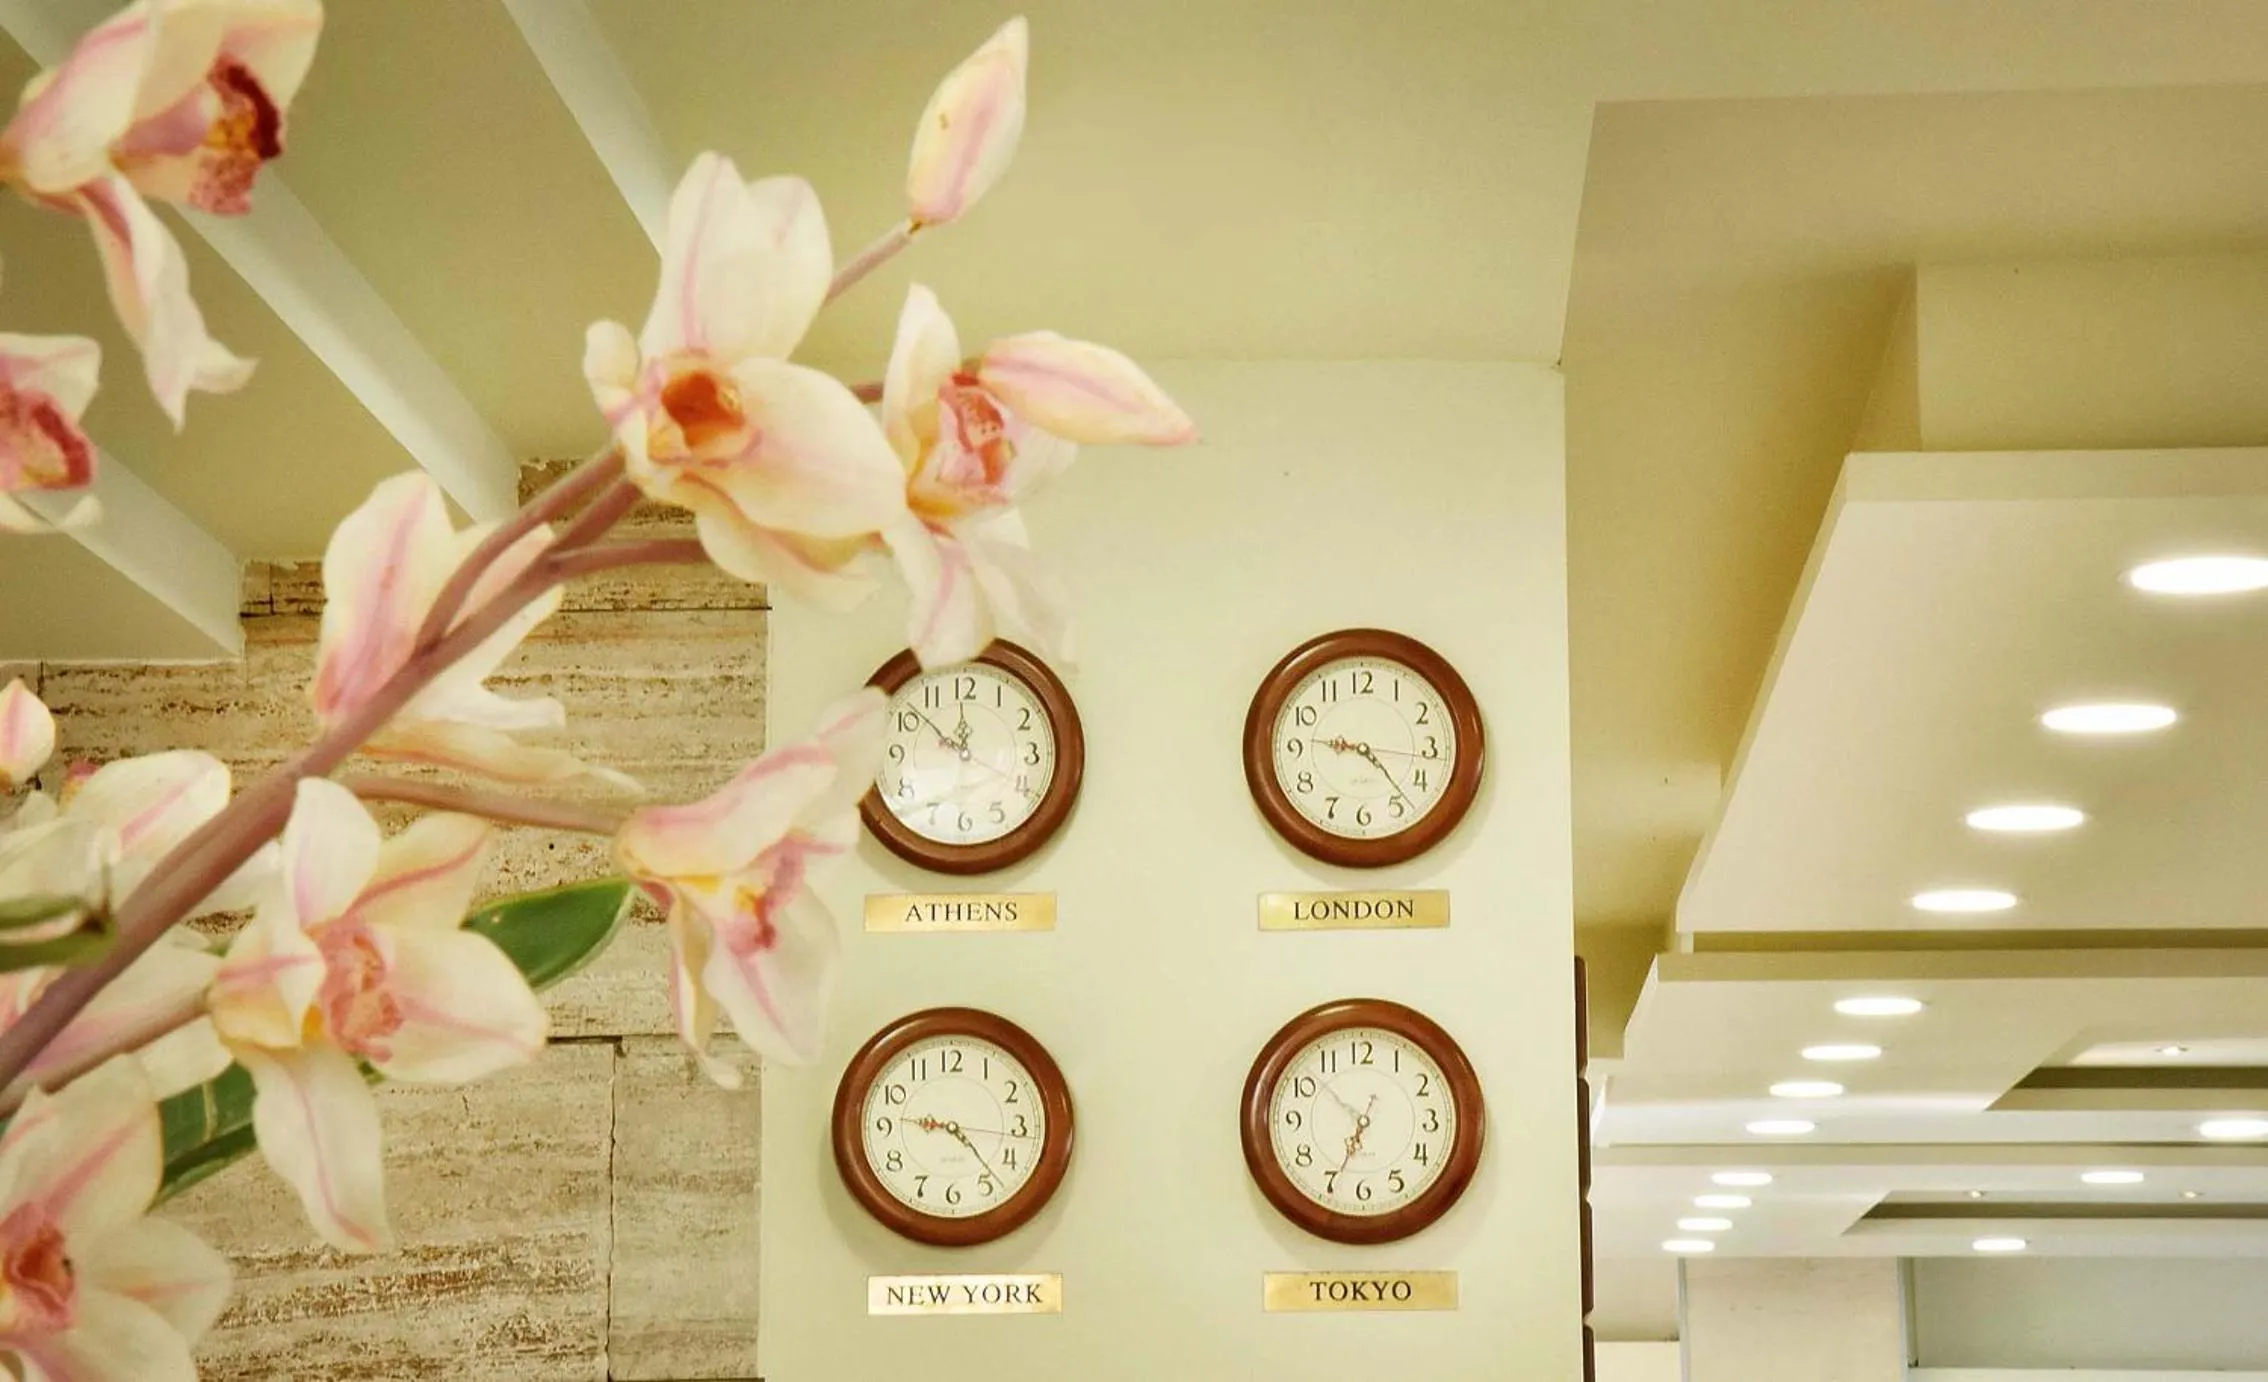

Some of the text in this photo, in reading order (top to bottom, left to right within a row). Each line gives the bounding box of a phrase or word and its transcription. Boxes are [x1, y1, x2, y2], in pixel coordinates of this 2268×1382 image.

[955, 677, 977, 700] 12
[1322, 680, 1336, 702] 11
[1352, 671, 1374, 694] 12
[1394, 679, 1399, 701] 1
[925, 685, 939, 708] 11
[996, 685, 1002, 708] 1
[898, 712, 920, 732] 10
[1017, 708, 1031, 731] 2
[1296, 705, 1317, 726] 10
[1416, 702, 1428, 725] 2
[889, 744, 905, 766] 9
[1024, 742, 1040, 766] 3
[1287, 738, 1303, 760] 9
[1422, 736, 1438, 760] 3
[898, 776, 914, 798] 8
[1015, 775, 1030, 797] 4
[1296, 770, 1314, 793] 8
[1413, 769, 1427, 792] 4
[926, 803, 940, 825] 7
[989, 802, 1006, 824] 5
[1325, 797, 1339, 819] 7
[1356, 804, 1372, 825] 6
[1388, 795, 1404, 818] 5
[957, 810, 973, 832] 6
[905, 902, 1018, 922] ATHENS
[1294, 899, 1413, 920] LONDON
[941, 1050, 963, 1072] 12
[1321, 1051, 1335, 1073] 11
[1352, 1041, 1374, 1065] 12
[1394, 1050, 1400, 1072] 1
[912, 1059, 926, 1081] 11
[983, 1057, 989, 1080] 1
[885, 1084, 906, 1105] 10
[1005, 1080, 1018, 1103] 2
[1294, 1076, 1316, 1098] 10
[1416, 1073, 1429, 1096] 2
[877, 1117, 893, 1138] 9
[1011, 1115, 1027, 1138] 3
[1286, 1110, 1302, 1132] 9
[1422, 1109, 1439, 1132] 3
[886, 1149, 903, 1172] 8
[1002, 1148, 1016, 1171] 4
[1295, 1144, 1312, 1167] 8
[1414, 1142, 1428, 1166] 4
[915, 1175, 929, 1198] 7
[977, 1174, 994, 1197] 5
[1324, 1171, 1338, 1194] 7
[1356, 1179, 1371, 1201] 6
[1388, 1169, 1404, 1193] 5
[946, 1183, 961, 1204] 6
[887, 1283, 1043, 1305] NEW YORK
[1310, 1280, 1412, 1301] TOKYO
